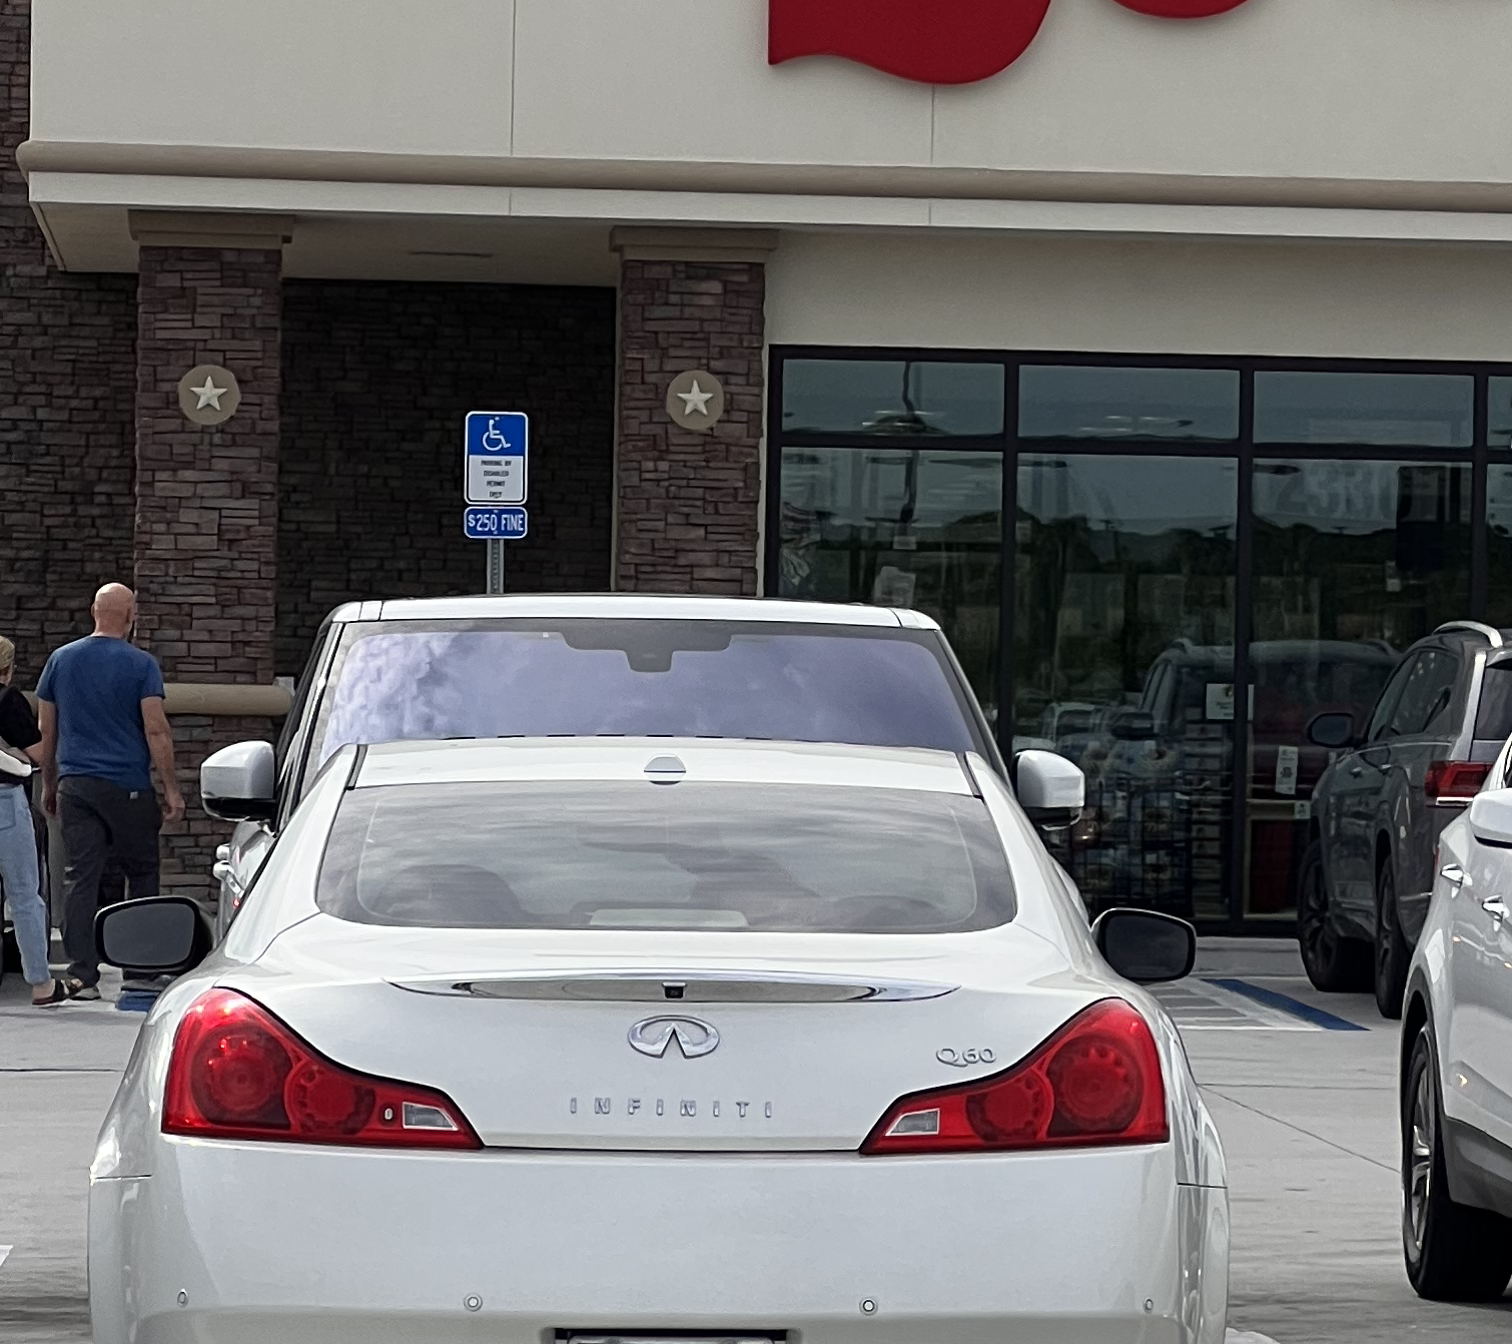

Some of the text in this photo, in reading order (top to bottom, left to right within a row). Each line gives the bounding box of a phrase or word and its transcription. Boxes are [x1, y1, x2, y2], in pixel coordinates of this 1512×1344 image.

[468, 514, 524, 531] $250 FINE
[936, 1047, 997, 1068] Q60
[570, 1097, 773, 1118] INFINITI
